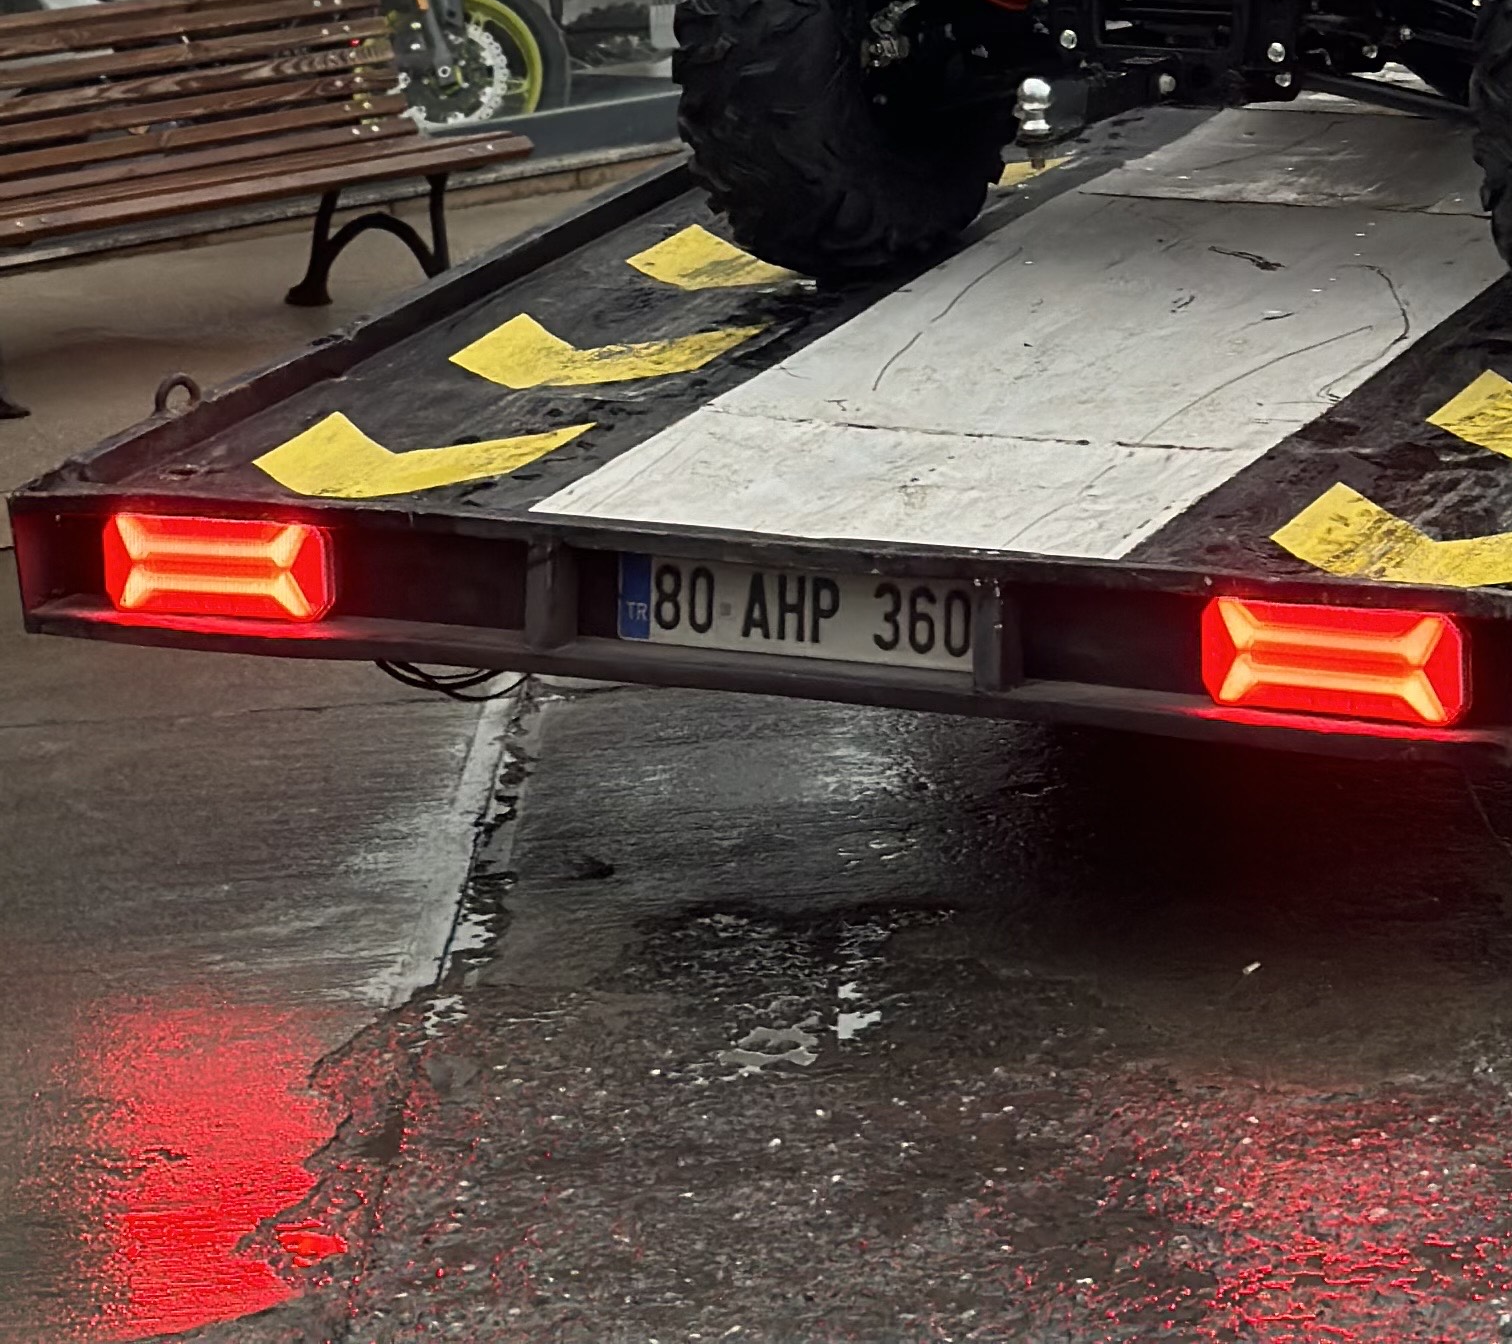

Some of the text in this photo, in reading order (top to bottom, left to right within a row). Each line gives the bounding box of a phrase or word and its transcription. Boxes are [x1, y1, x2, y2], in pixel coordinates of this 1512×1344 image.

[626, 563, 973, 658] TR 80 AHP 360
